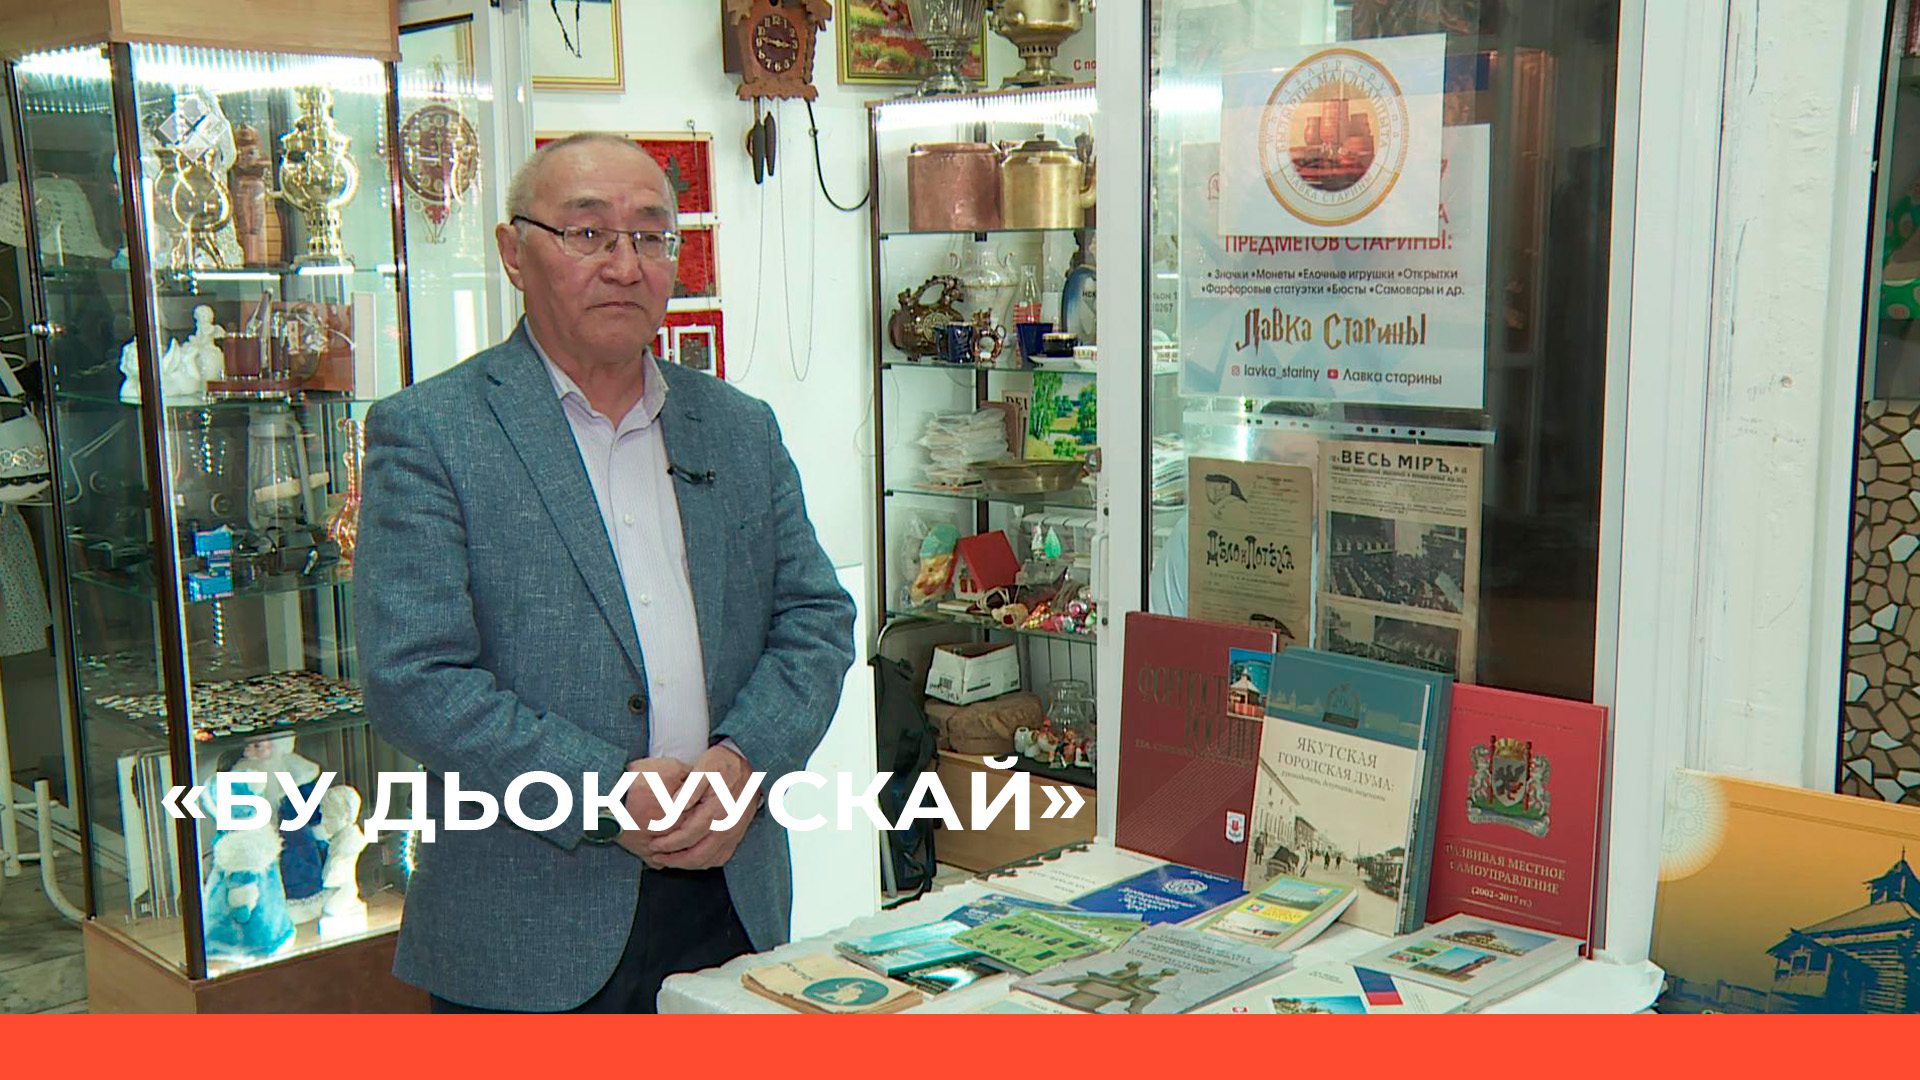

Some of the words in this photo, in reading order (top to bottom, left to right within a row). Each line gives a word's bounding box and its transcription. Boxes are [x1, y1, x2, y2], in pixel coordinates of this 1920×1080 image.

[1225, 234, 1339, 255] ПРЕДМЕТОВ
[1215, 269, 1248, 280] Значки
[1256, 269, 1295, 280] Монеты
[1349, 270, 1395, 281] игрушки
[1403, 268, 1458, 281] Открытки
[1206, 283, 1271, 296] Фарфоровые
[1273, 286, 1324, 296] статуэтки
[1332, 284, 1366, 295] Бюсты
[1375, 284, 1434, 296] Самовары
[1437, 287, 1444, 295] и
[1446, 286, 1465, 297] др.
[1235, 307, 1312, 356] Лавка
[1324, 312, 1426, 350] Старины
[1244, 365, 1320, 382] lavka_stariny
[1343, 368, 1382, 383] Лавка
[1385, 371, 1442, 387] старины
[1341, 450, 1391, 468] ВЕСЬ
[1297, 737, 1377, 769] ЯКУТСКАЯ
[1278, 752, 1351, 781] ГОРОДСКАЯ
[1354, 770, 1394, 792] ДУМА:
[1445, 844, 1506, 867] РАЗВИВАЯ
[1508, 858, 1565, 881] МЕСТНОЕ
[1450, 861, 1559, 895] САМОУПРАВЛЕНИЕ
